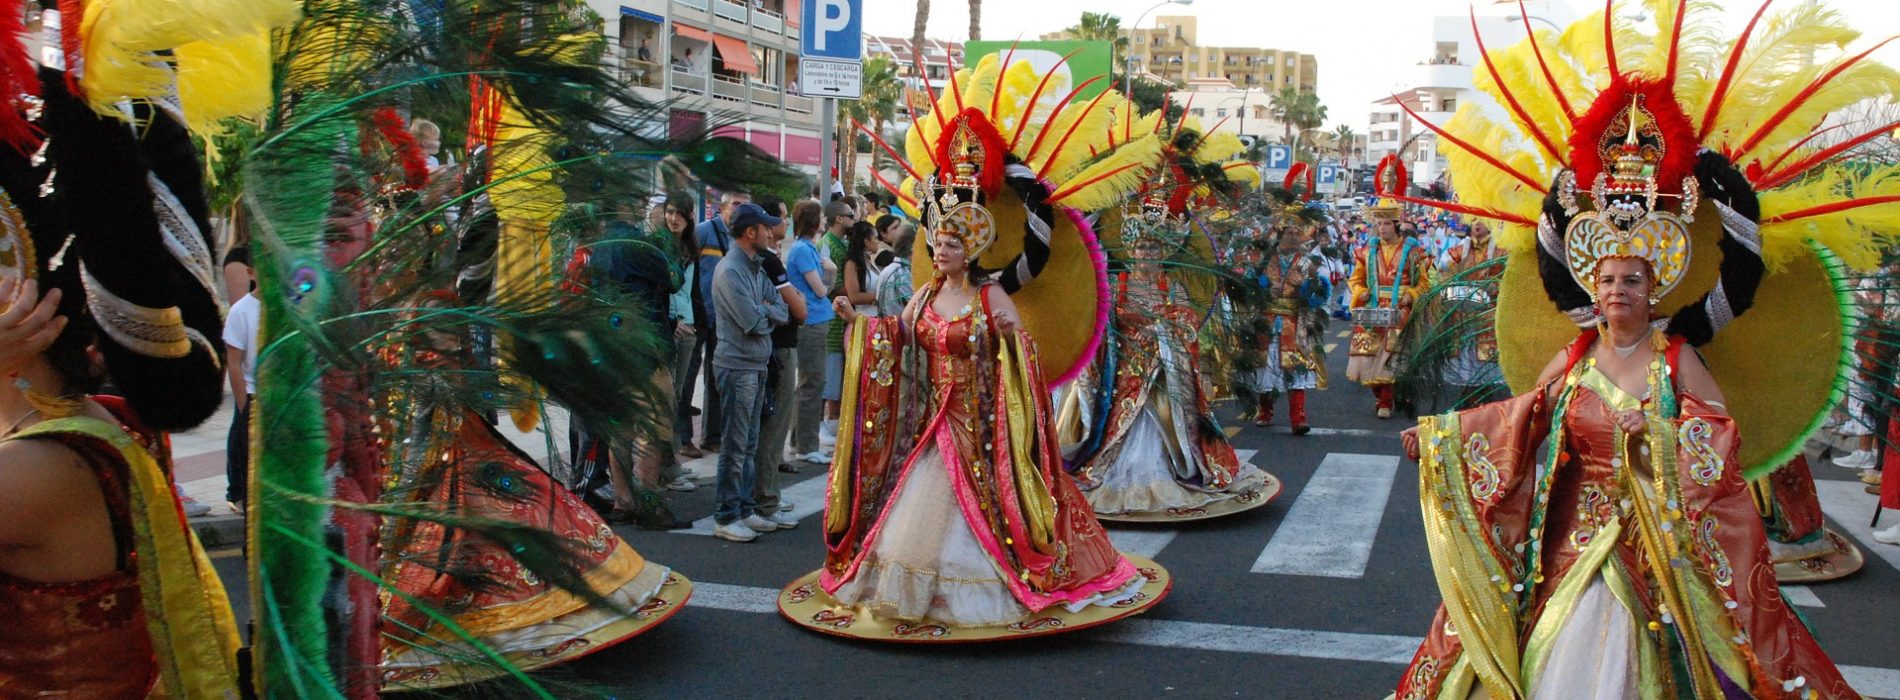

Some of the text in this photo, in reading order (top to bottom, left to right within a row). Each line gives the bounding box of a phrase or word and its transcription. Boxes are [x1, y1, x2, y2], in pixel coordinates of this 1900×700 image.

[814, 0, 850, 51] P
[1270, 147, 1285, 168] P
[1320, 166, 1332, 182] P
